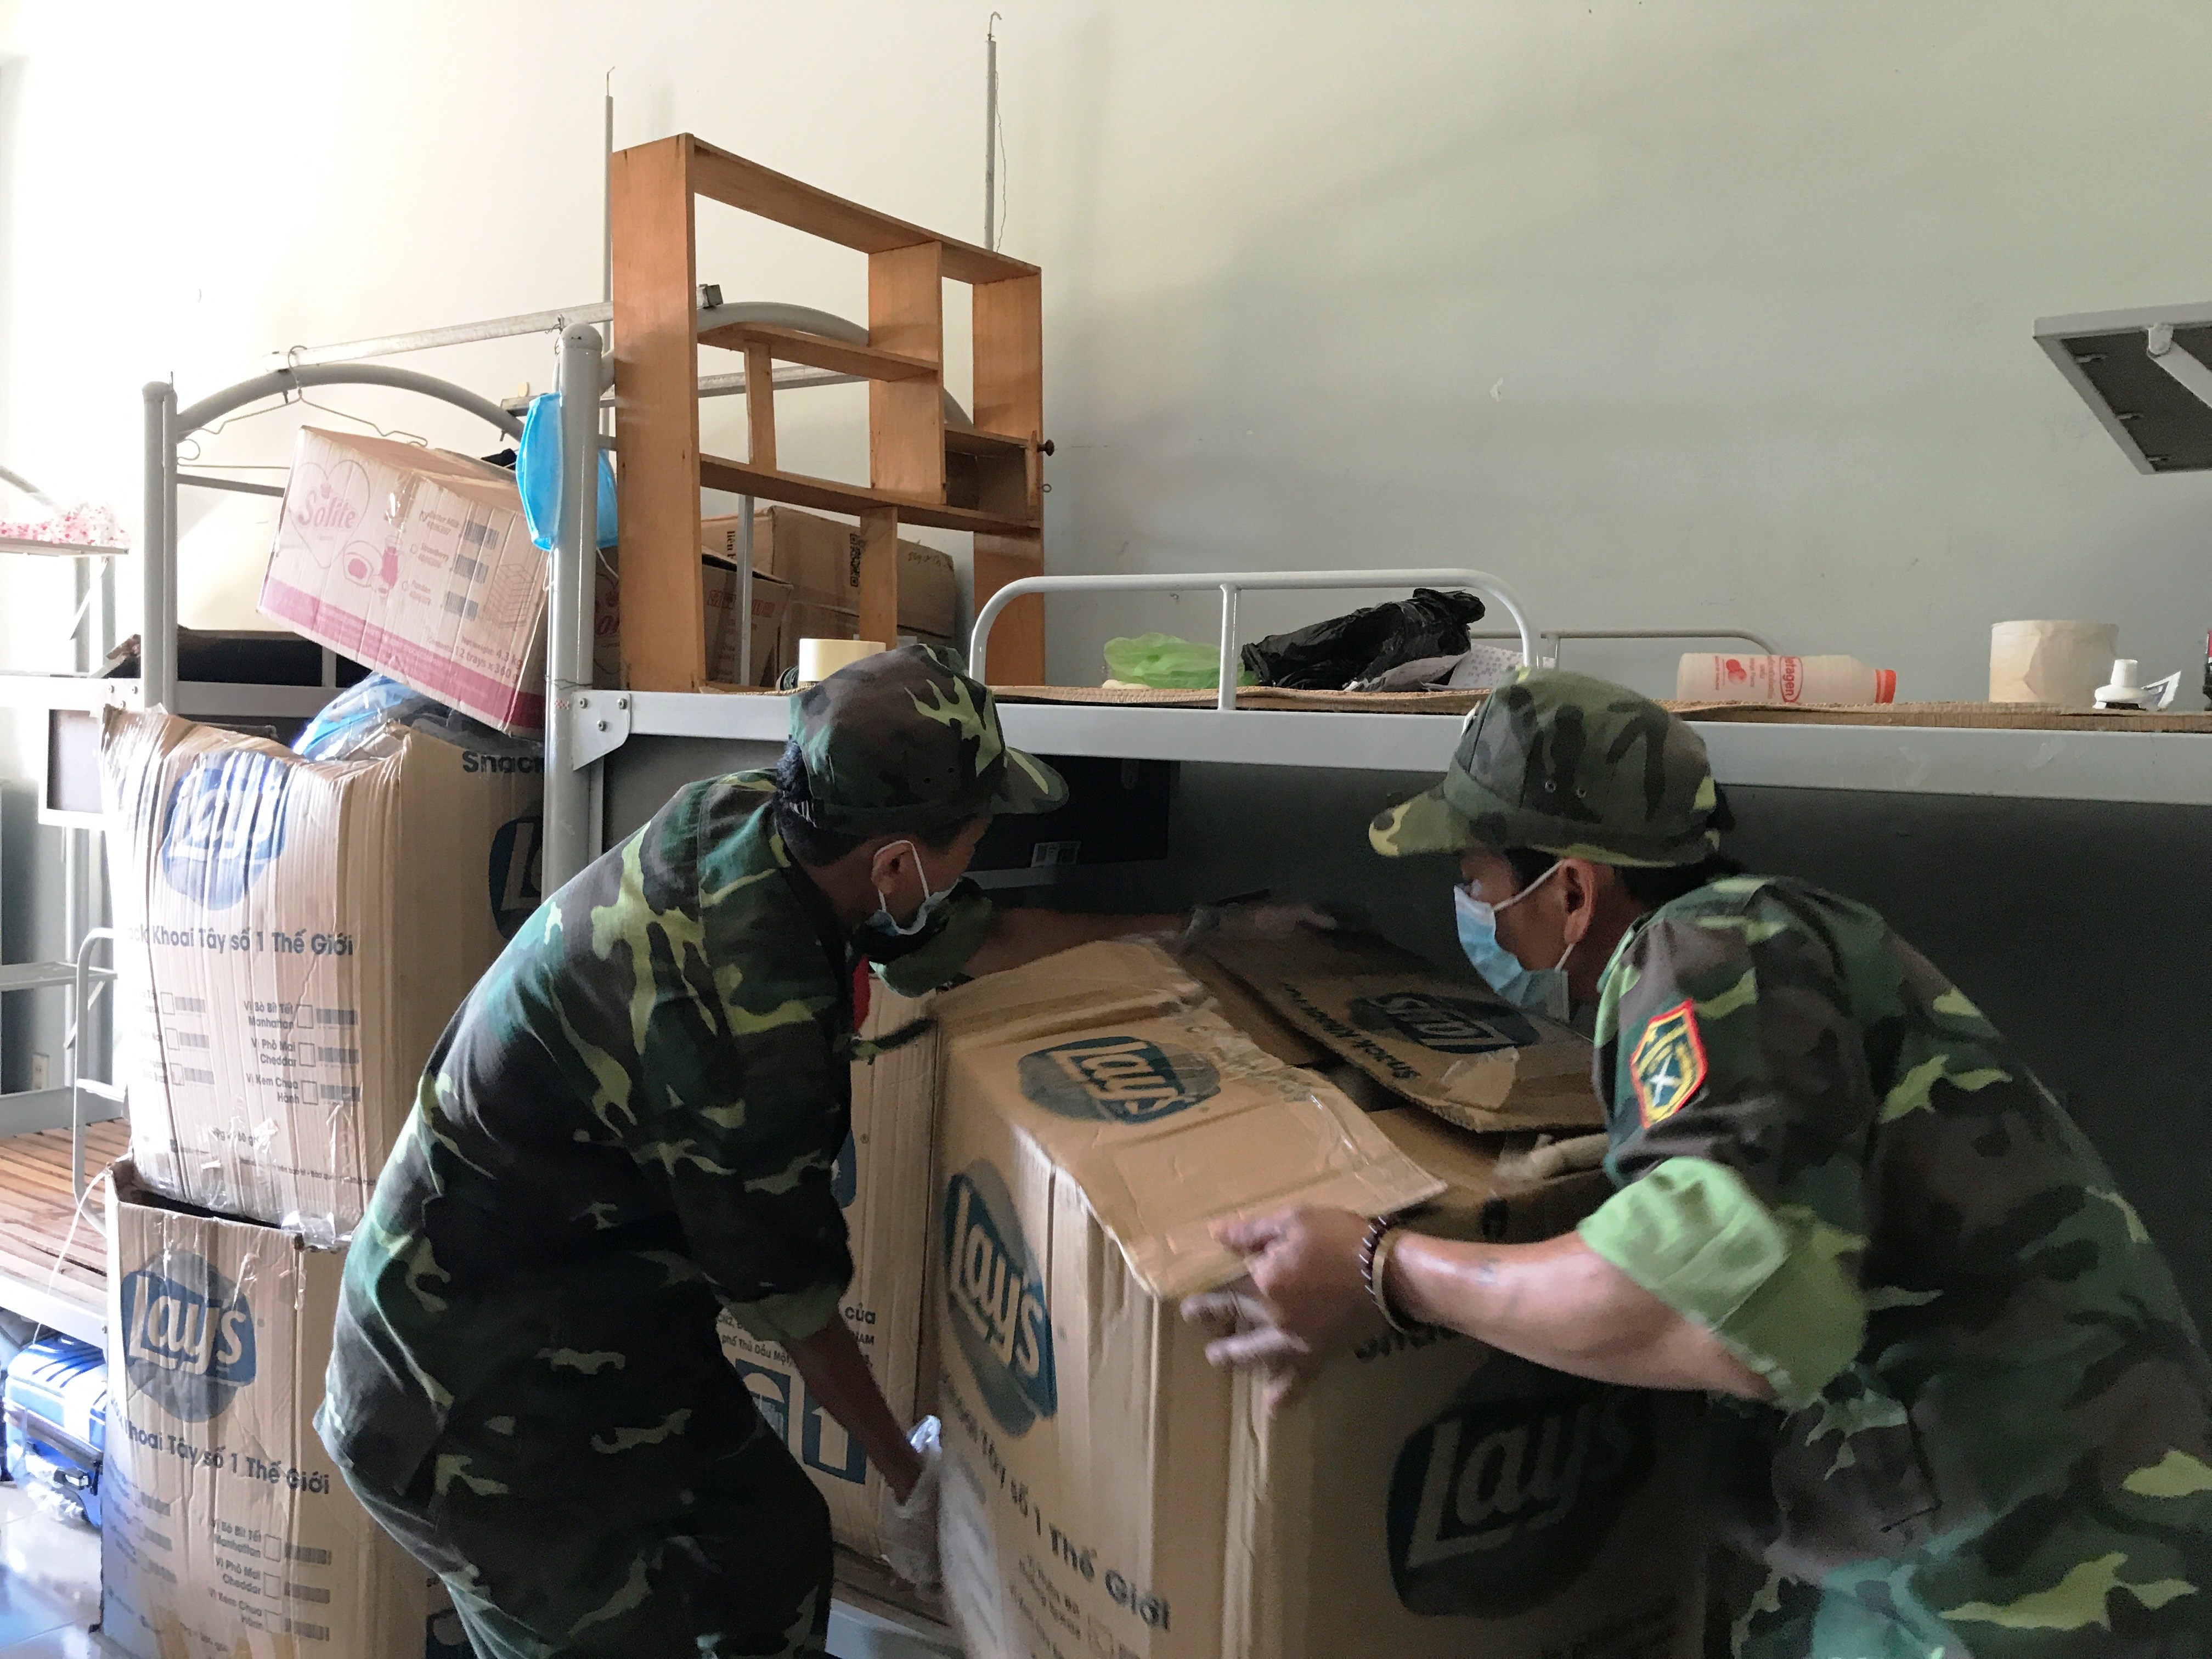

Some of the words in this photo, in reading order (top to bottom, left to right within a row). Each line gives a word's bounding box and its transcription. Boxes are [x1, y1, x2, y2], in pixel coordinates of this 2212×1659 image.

[297, 488, 356, 529] Solite
[455, 646, 466, 659] 12
[466, 651, 487, 668] trays
[152, 925, 194, 947] Khoai
[199, 927, 226, 954] Tây
[230, 927, 251, 951] số
[256, 931, 264, 952] 1
[272, 928, 307, 953] Thế
[311, 932, 353, 956] Giới
[249, 1015, 294, 1029] Manhattan
[260, 1053, 297, 1066] Cheddar
[256, 1074, 274, 1086] Kem
[845, 1302, 876, 1325] của
[167, 1434, 198, 1466] Tây
[203, 1445, 226, 1469] số
[232, 1452, 238, 1474] 1
[246, 1457, 282, 1483] Thế
[286, 1468, 330, 1495] Giới
